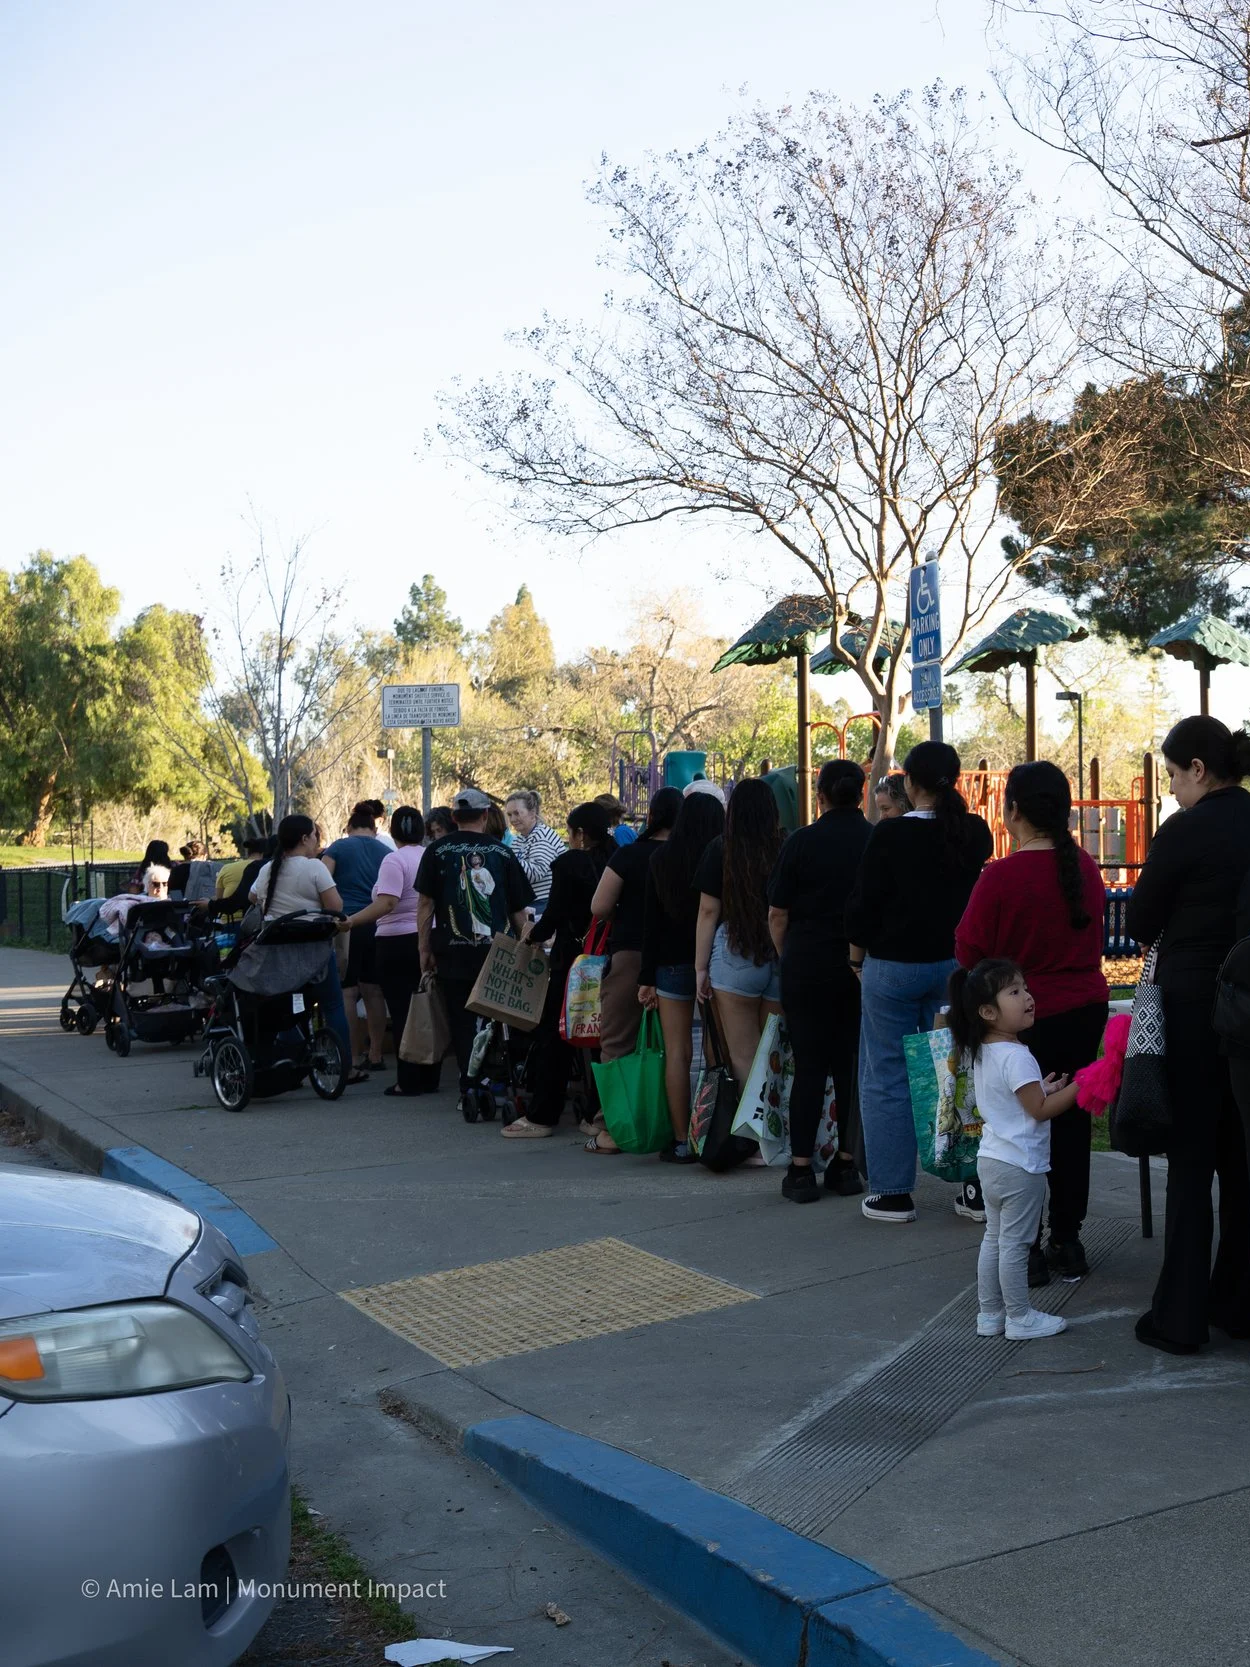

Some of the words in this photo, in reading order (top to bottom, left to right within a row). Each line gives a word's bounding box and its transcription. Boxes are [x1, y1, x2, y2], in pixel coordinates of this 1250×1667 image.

[912, 612, 940, 637] PARKING
[918, 635, 936, 658] ONLY
[495, 947, 517, 965] IT'S
[486, 973, 509, 992] NOT
[510, 984, 523, 997] IN
[492, 960, 534, 988] WHAT'S
[484, 987, 506, 1005] THE
[508, 996, 533, 1014] BAG.
[576, 1024, 601, 1034] FRAN
